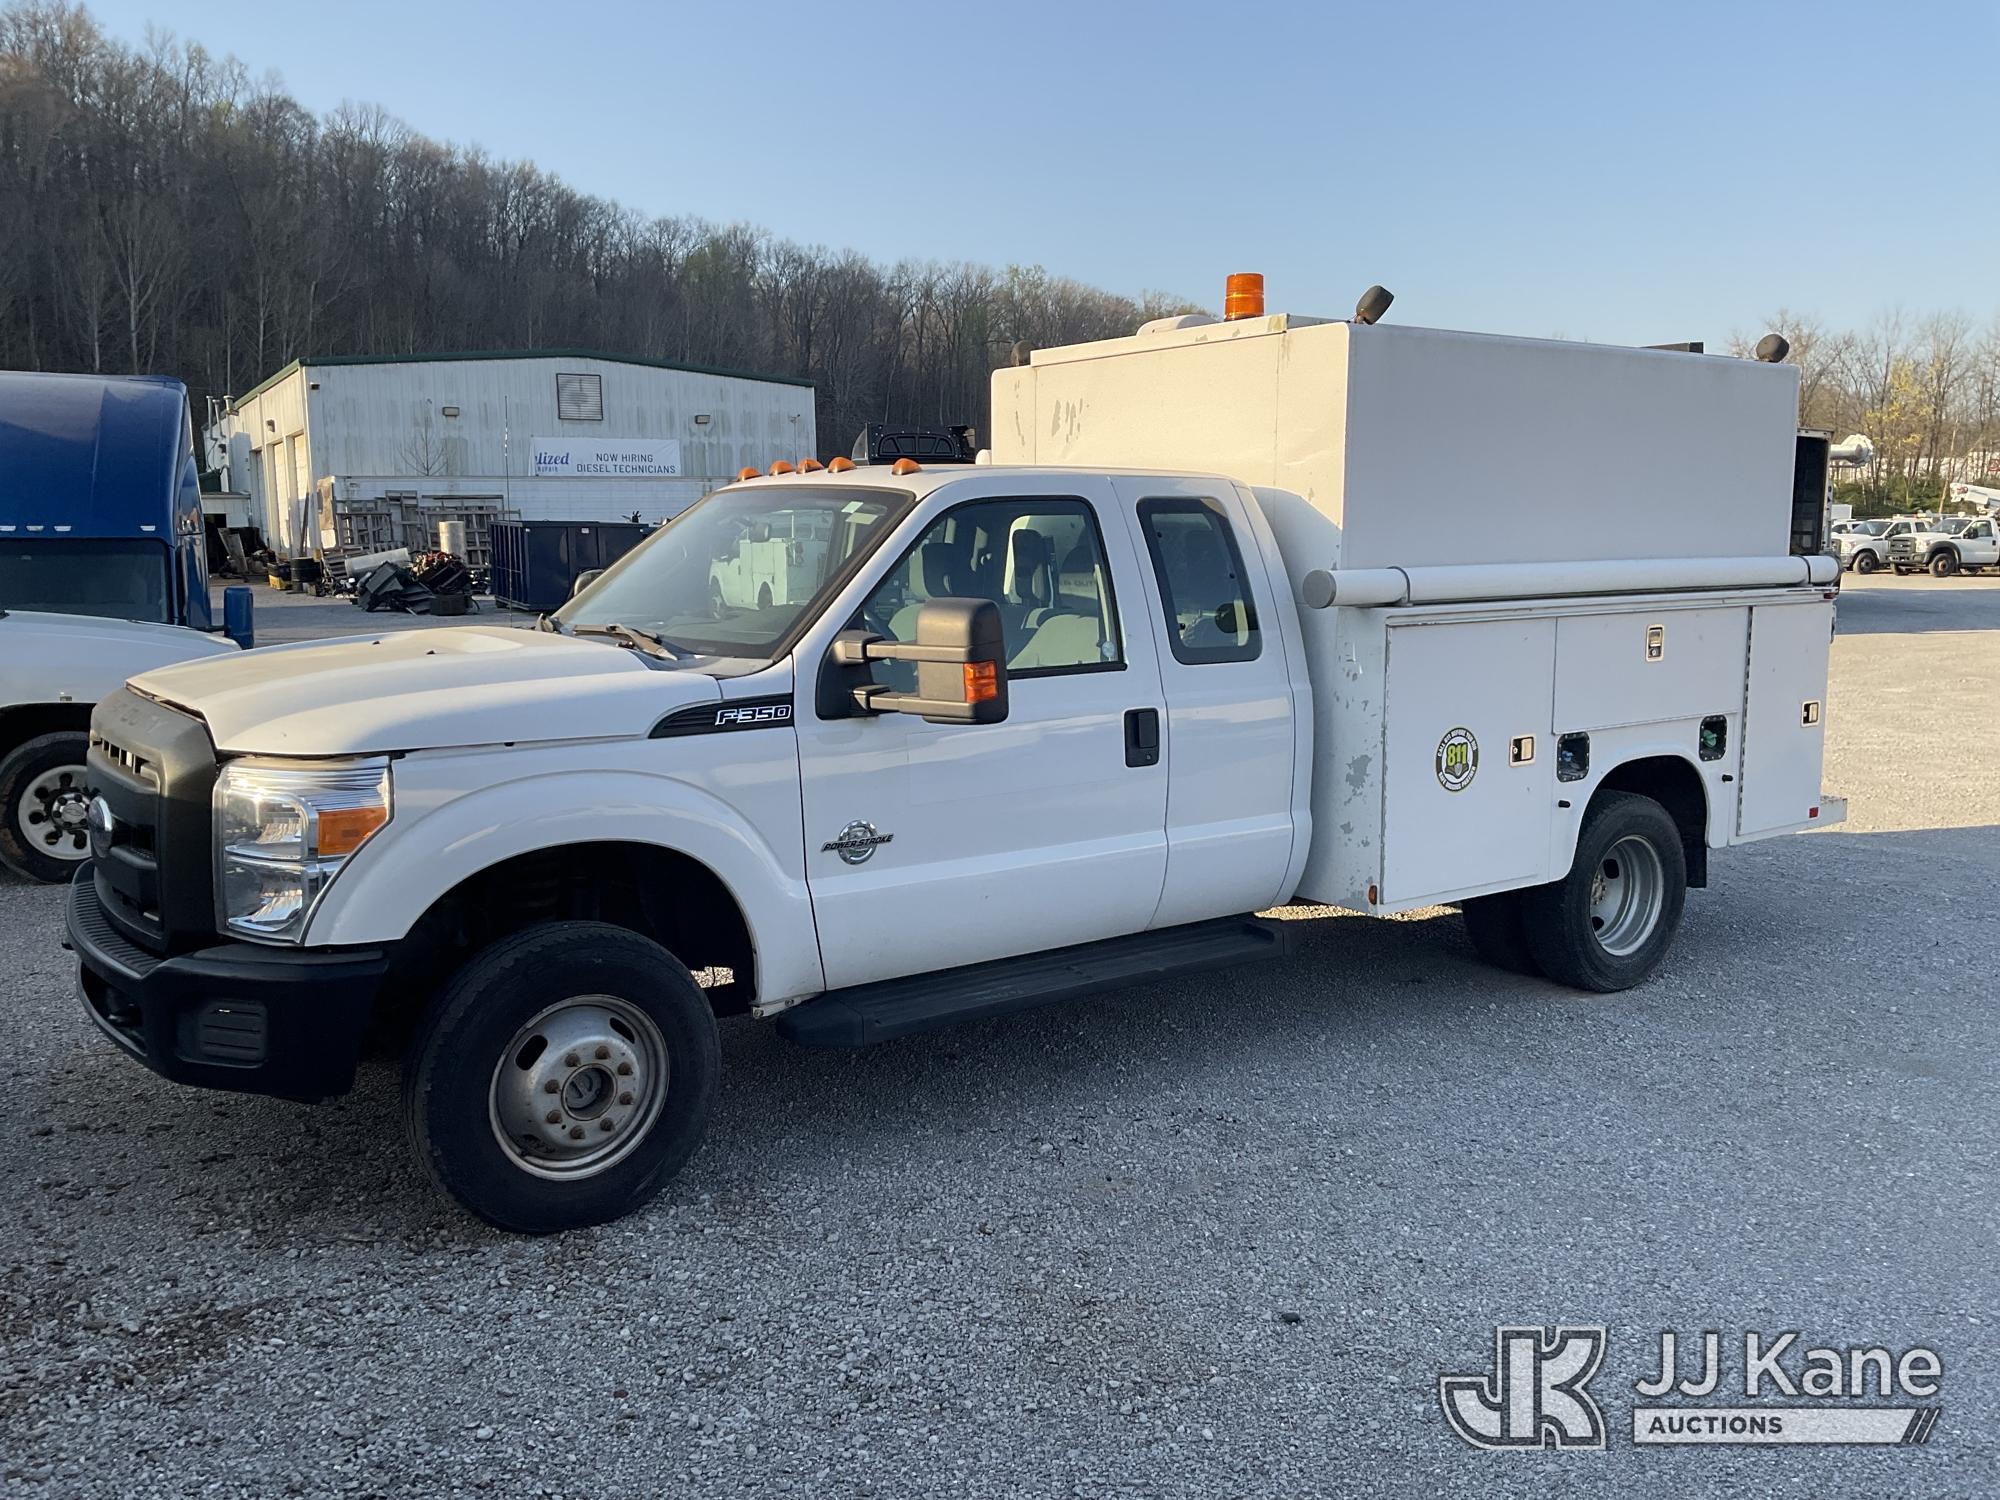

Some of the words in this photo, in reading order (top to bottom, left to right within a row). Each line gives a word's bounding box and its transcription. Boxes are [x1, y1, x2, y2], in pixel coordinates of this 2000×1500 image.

[596, 453, 618, 462] NOW
[621, 453, 654, 463] HIRING
[576, 463, 611, 473] DIESEL
[613, 464, 676, 474] TECHNICIANS
[714, 704, 792, 726] F-350
[1446, 742, 1468, 767] 811
[822, 840, 857, 852] POWER
[857, 834, 894, 847] STROKE
